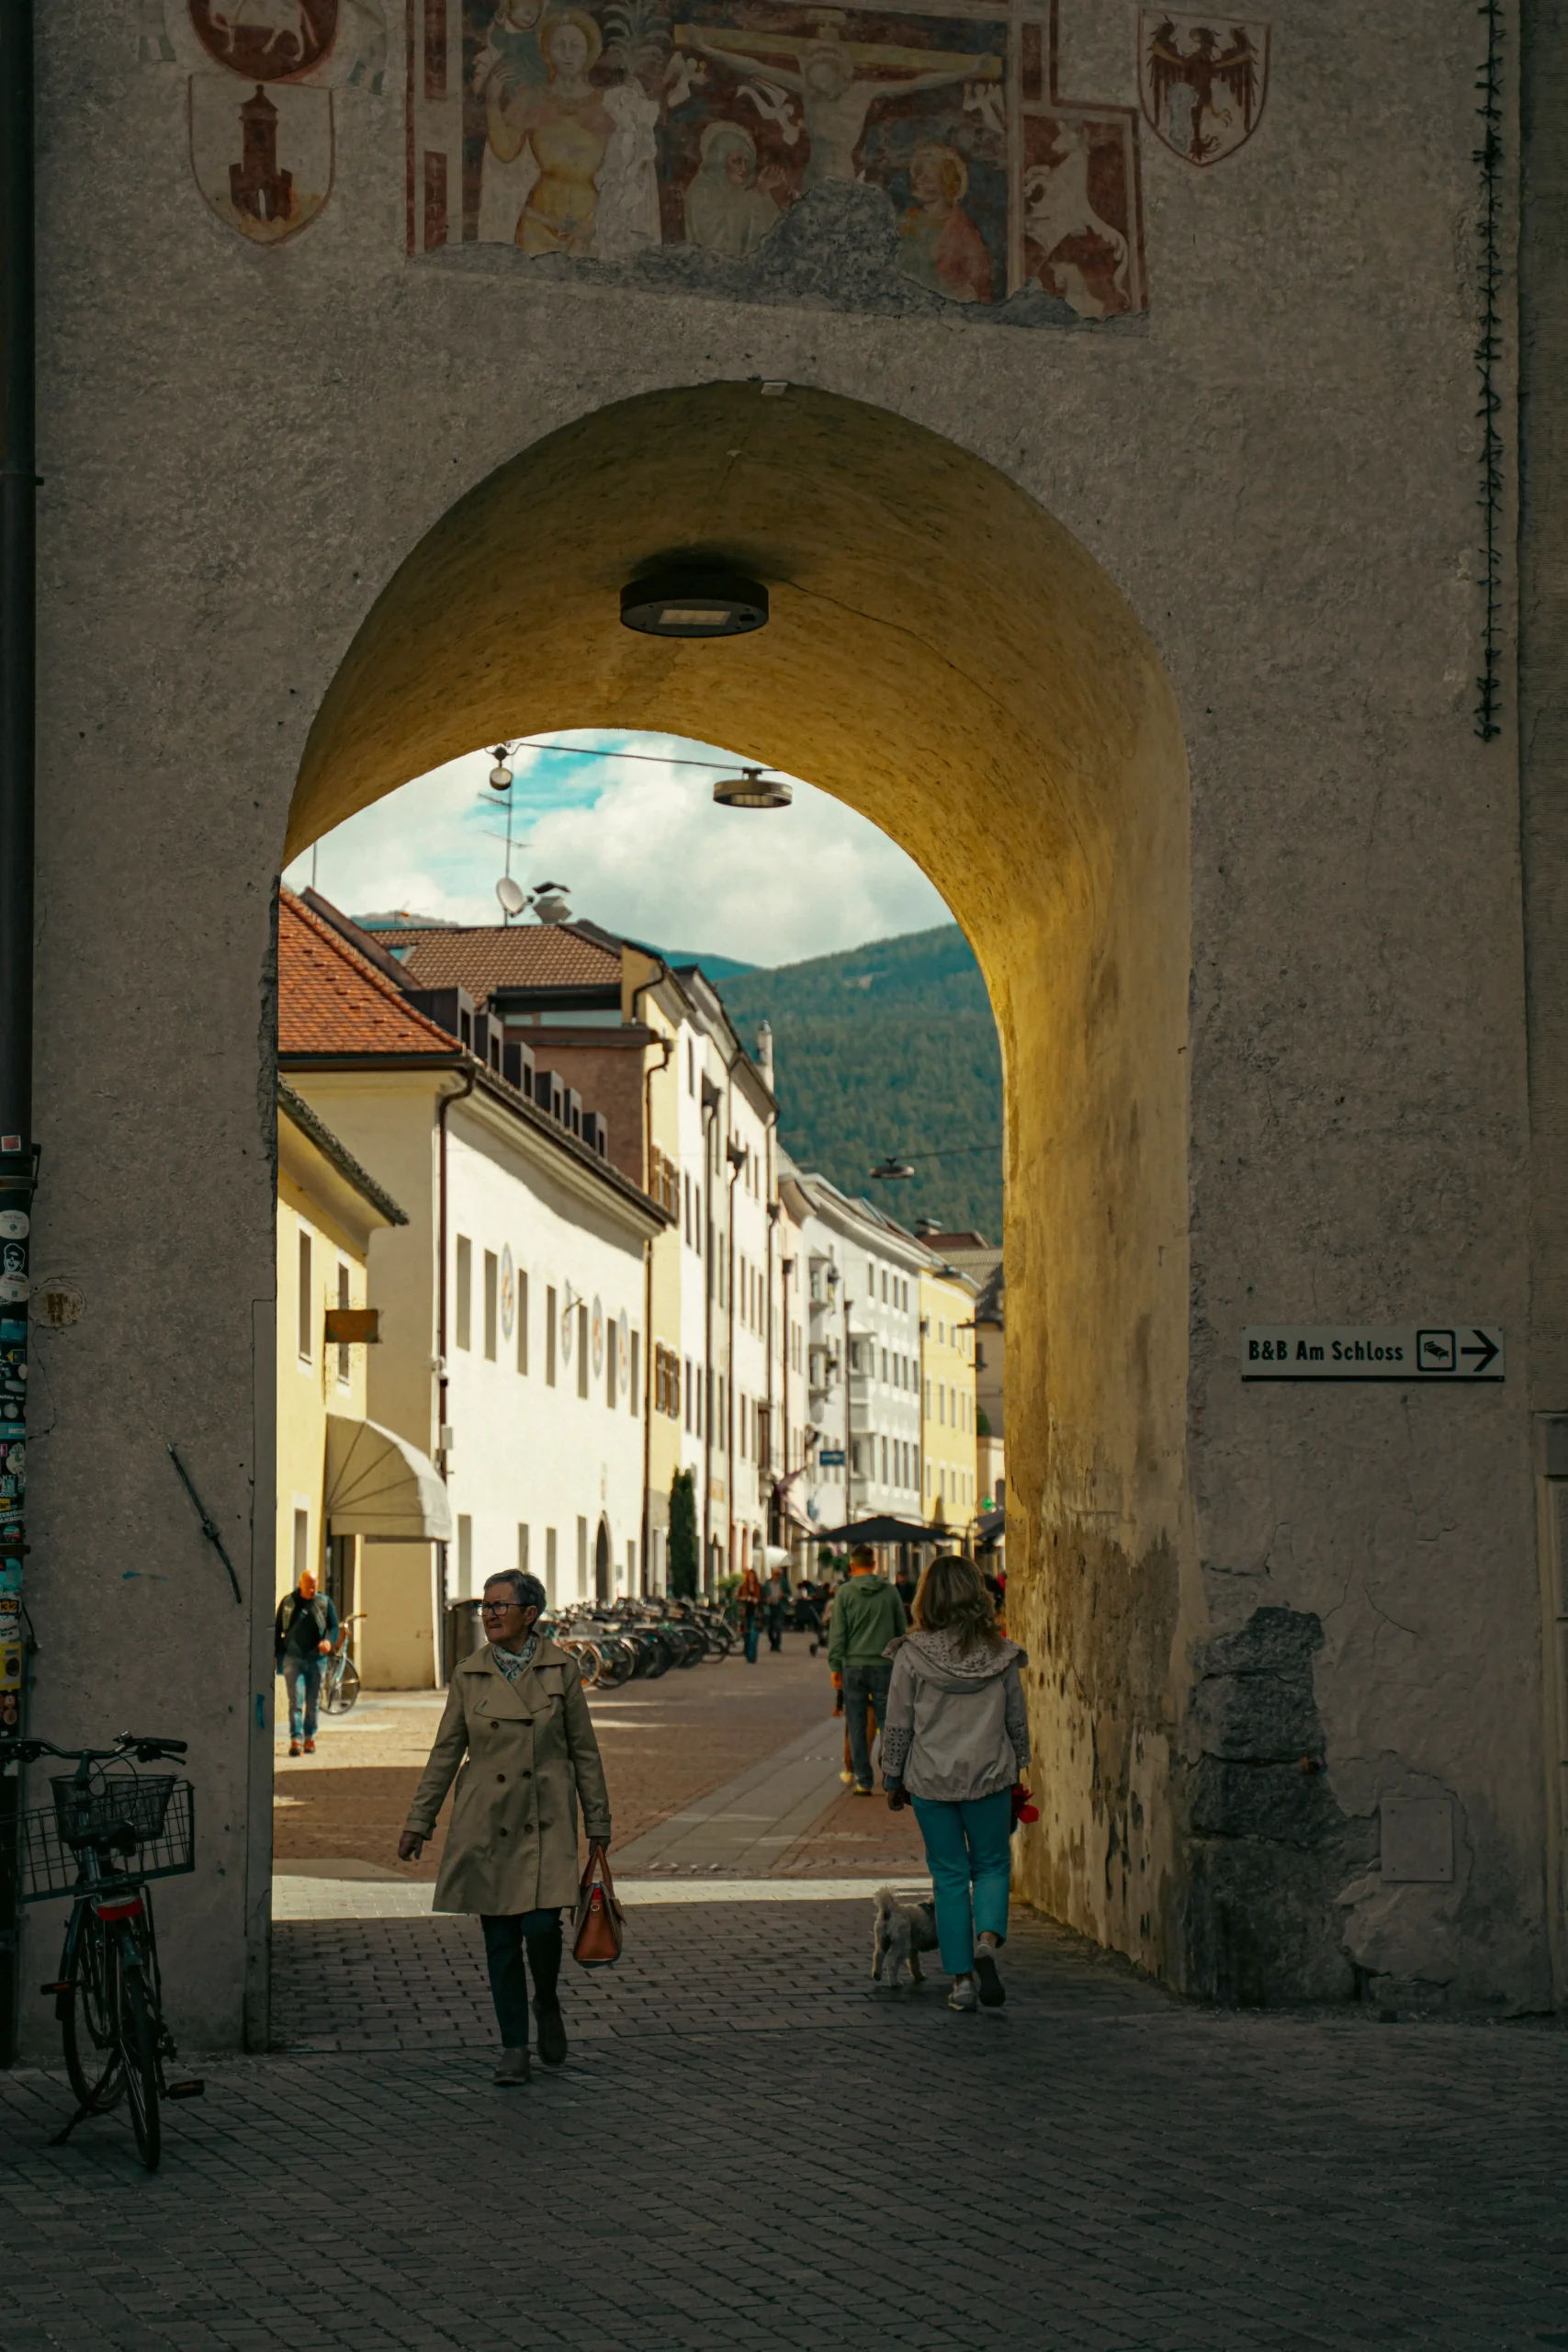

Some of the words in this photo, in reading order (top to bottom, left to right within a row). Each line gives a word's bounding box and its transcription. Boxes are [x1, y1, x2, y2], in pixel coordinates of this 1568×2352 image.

[1248, 1340, 1288, 1361] B&B
[1296, 1340, 1325, 1361] Am
[1331, 1340, 1404, 1361] Schloss
